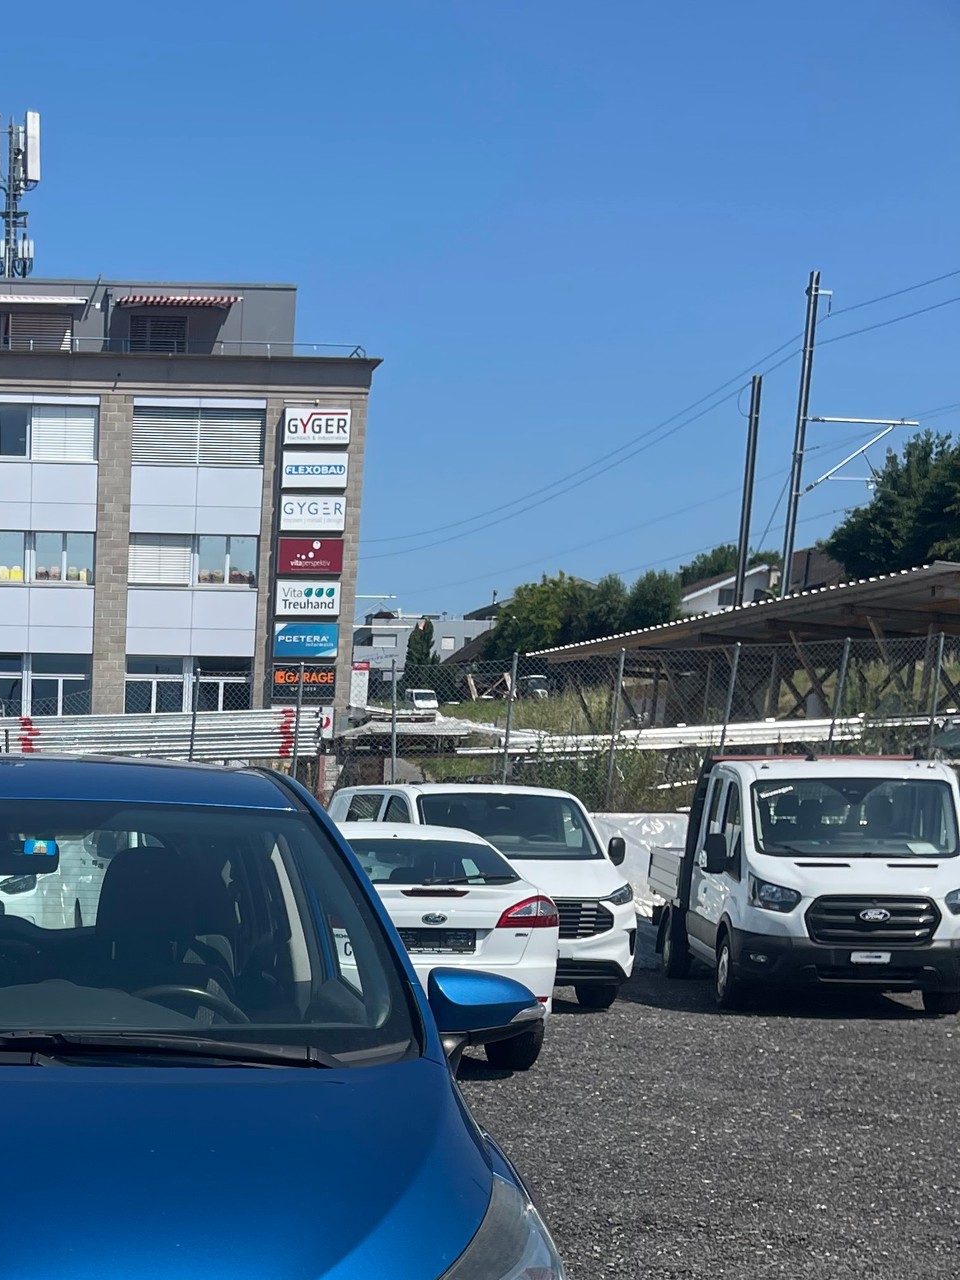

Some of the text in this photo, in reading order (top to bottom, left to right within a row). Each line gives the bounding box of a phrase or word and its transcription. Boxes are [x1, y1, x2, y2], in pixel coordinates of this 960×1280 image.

[287, 415, 347, 434] GYGER
[286, 466, 344, 474] FLEXOBAU
[283, 502, 343, 515] GYGER
[289, 560, 331, 568] vitaperspektiv
[282, 587, 303, 598] Vita
[282, 599, 334, 609] Treuhand
[277, 635, 329, 643] PCETERA
